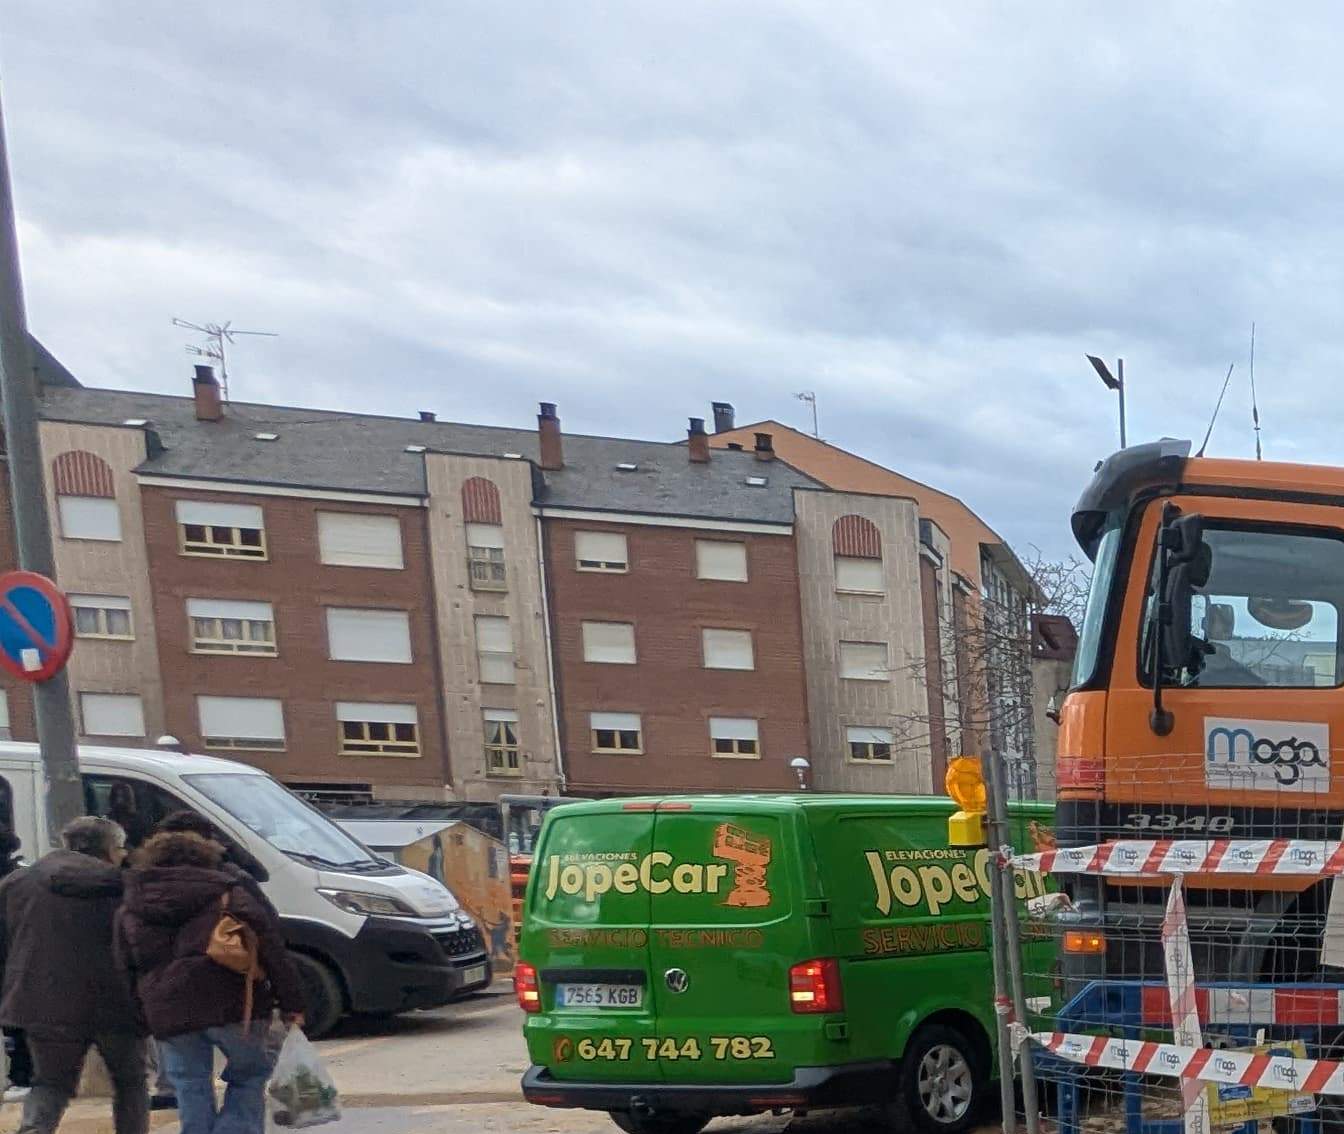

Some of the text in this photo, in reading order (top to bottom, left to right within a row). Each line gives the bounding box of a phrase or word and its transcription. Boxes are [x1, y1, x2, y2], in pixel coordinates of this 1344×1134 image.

[1122, 814, 1235, 832] 3340
[885, 850, 967, 861] ELEVACIONES
[545, 851, 727, 902] JopeCar
[863, 922, 983, 955] SERVICIO
[607, 988, 638, 1005] KGB
[577, 1036, 776, 1060] 647 744 782
